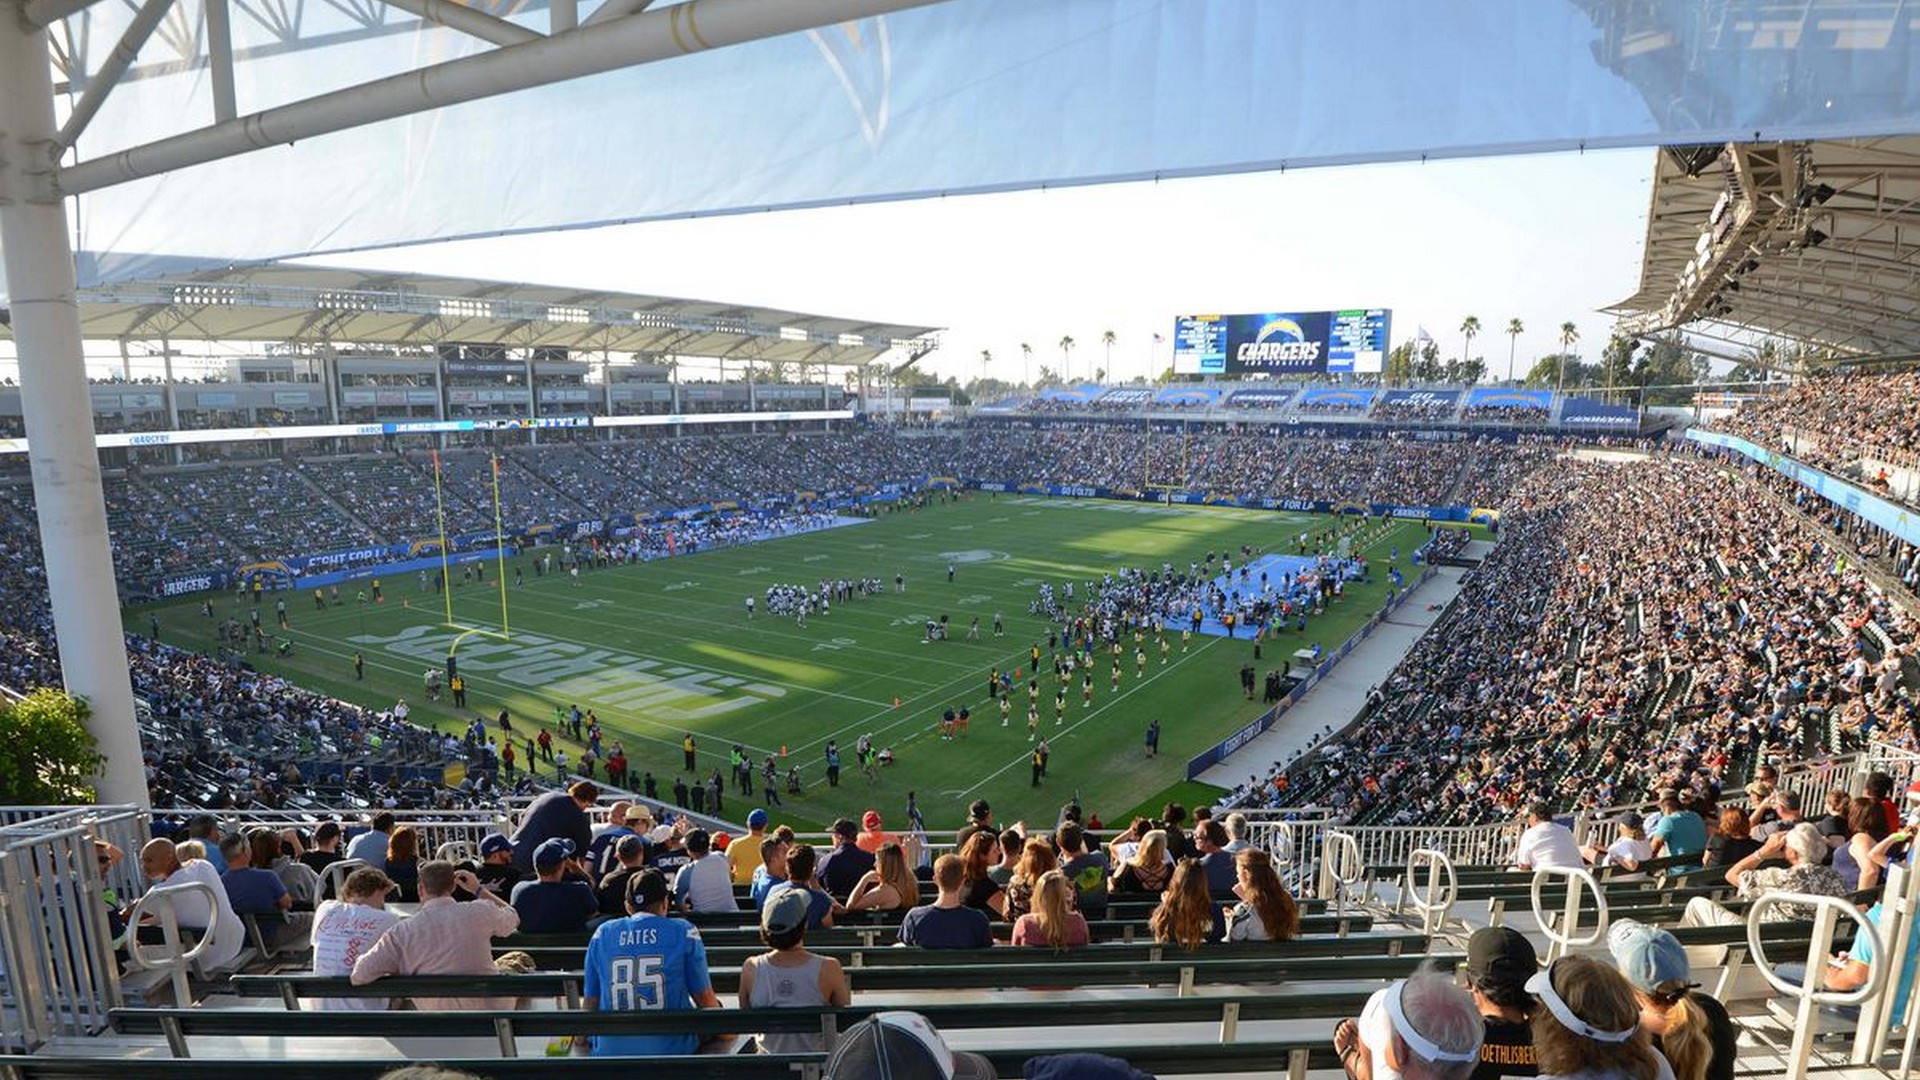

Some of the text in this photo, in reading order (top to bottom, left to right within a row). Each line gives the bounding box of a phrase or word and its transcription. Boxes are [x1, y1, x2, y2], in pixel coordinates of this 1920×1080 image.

[1237, 341, 1321, 362] CHARGERS
[619, 928, 657, 946] GATES
[611, 955, 665, 1011] 85
[1481, 1043, 1538, 1065] OETHLISBER
